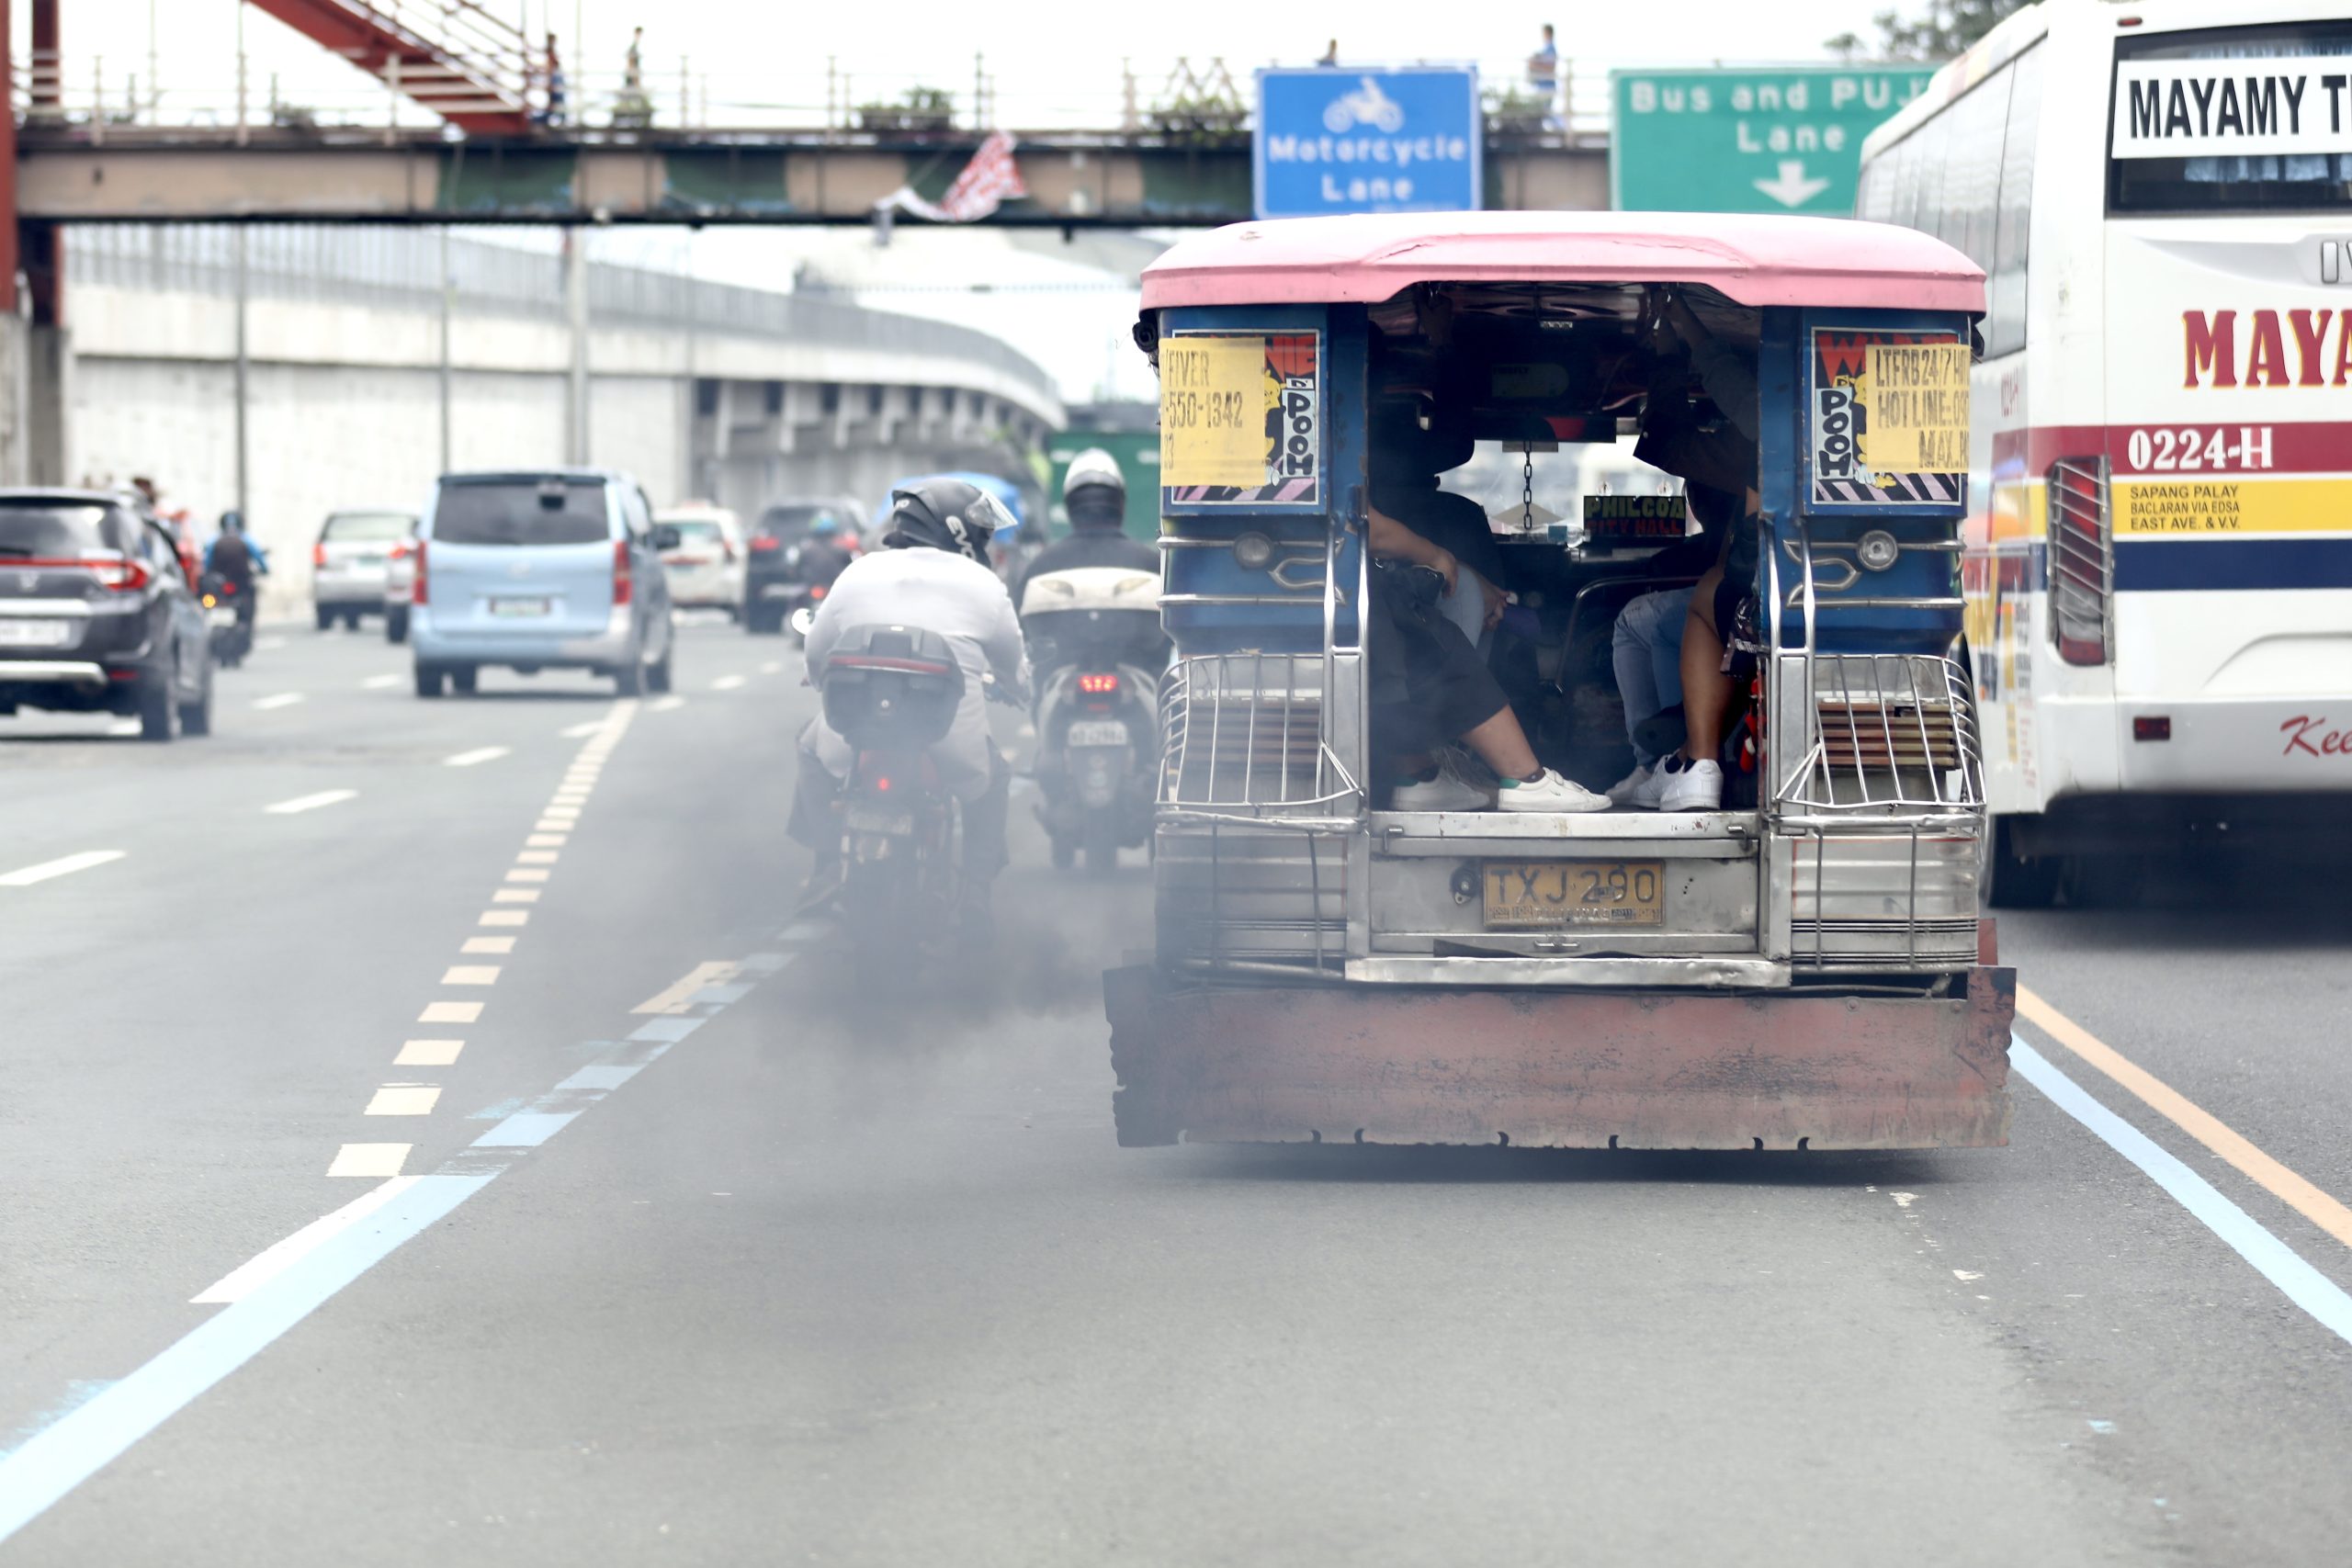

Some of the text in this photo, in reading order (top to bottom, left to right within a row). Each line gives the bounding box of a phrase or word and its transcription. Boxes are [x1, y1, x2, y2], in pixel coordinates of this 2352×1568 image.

[1631, 81, 1712, 112] Bus
[1731, 79, 1809, 111] and
[2129, 76, 2307, 139] MAYAMY
[1269, 134, 1466, 167] Motorcycle
[1736, 121, 1847, 152] Lane
[1321, 173, 1413, 201] Lane
[1287, 392, 1314, 475] POOH
[1818, 389, 1851, 477] POOH
[2128, 426, 2273, 470] 0224-H
[2131, 485, 2238, 500] SAPANG PALAY
[2131, 501, 2240, 514] BACLARAN VIA EDSA
[1585, 497, 1686, 520] PHILCOA
[2132, 517, 2166, 530] EAST
[2170, 517, 2201, 530] AVE.
[2205, 516, 2215, 529] &
[1635, 518, 1682, 535] HALL
